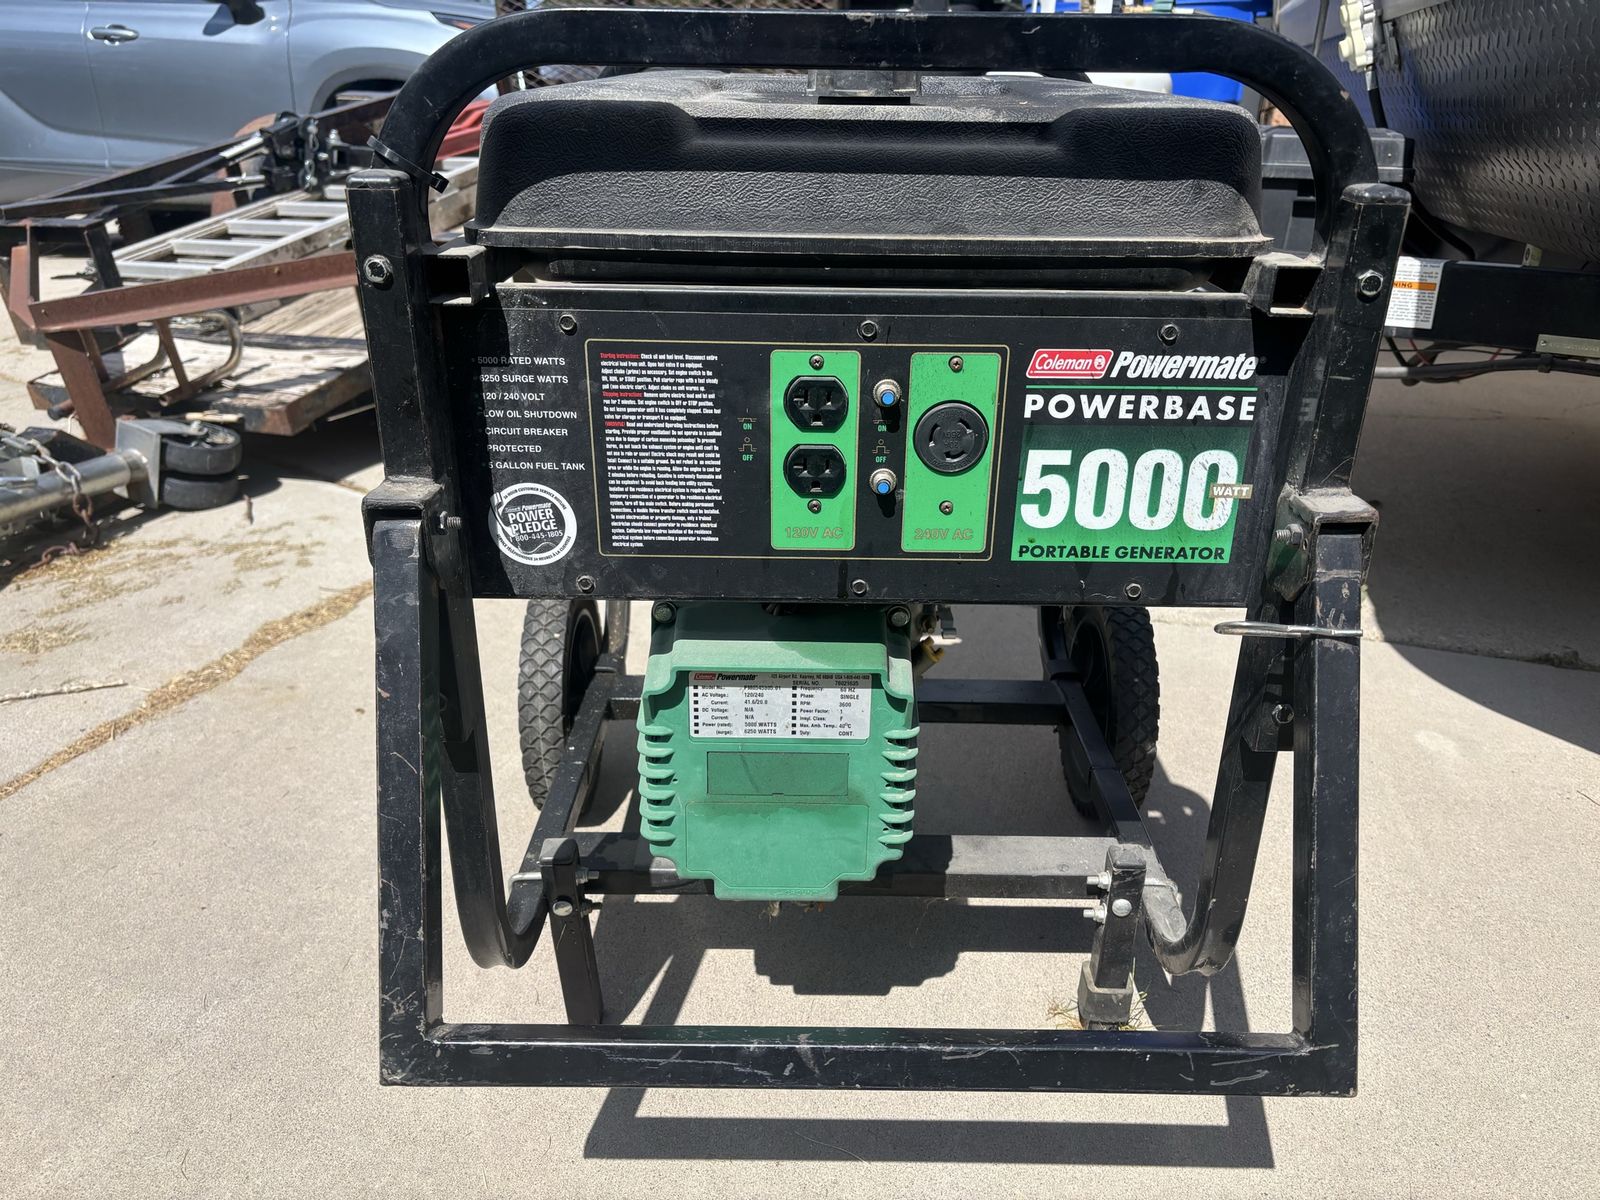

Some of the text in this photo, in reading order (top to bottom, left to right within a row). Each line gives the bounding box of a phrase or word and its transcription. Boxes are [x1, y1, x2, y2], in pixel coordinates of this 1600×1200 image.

[534, 357, 565, 365] WATTS
[1035, 350, 1258, 380] Coleman Powermate
[1024, 393, 1257, 421] POWERBASE
[485, 427, 521, 435] CIRCUIT
[1020, 448, 1239, 531] 5000
[1211, 486, 1250, 497] WATT
[508, 508, 554, 523] POWER
[511, 519, 558, 534] PLEDGE
[785, 527, 844, 539] 120V AC
[914, 528, 974, 540] 240V AC
[1018, 545, 1225, 560] PORTABLE GENERATOR
